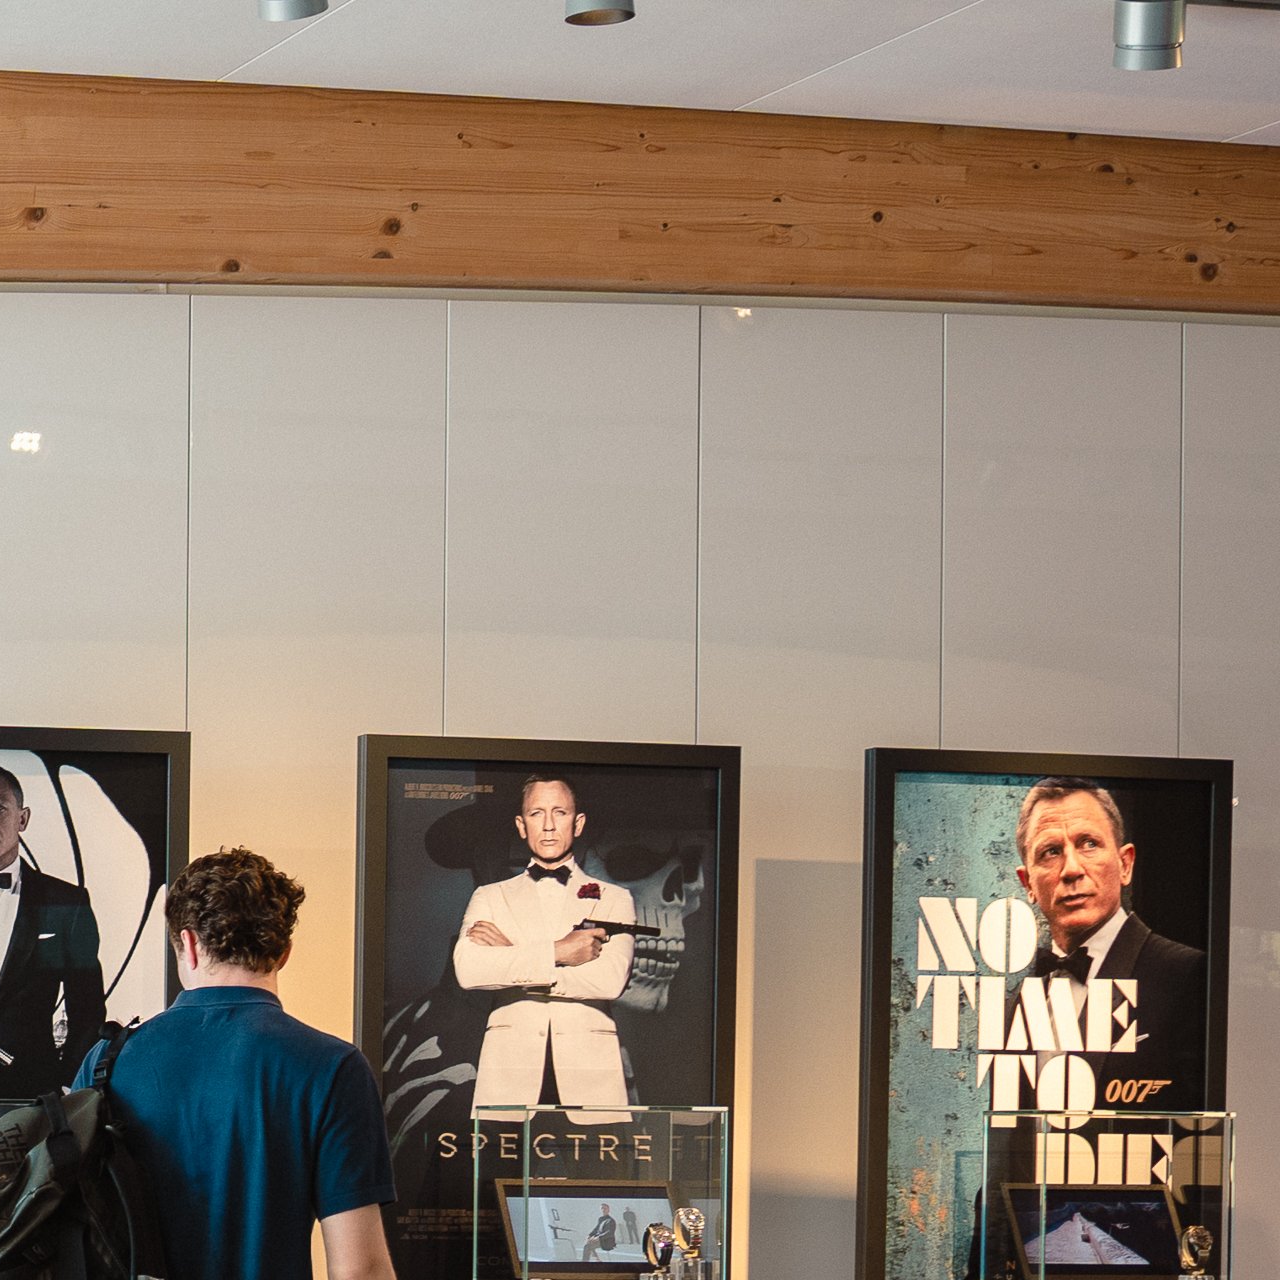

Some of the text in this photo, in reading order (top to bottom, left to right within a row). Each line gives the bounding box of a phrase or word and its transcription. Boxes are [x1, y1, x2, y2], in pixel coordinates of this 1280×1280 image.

[917, 896, 1038, 973] NO
[916, 975, 1138, 1053] TIME
[976, 1054, 1096, 1130] TO
[1105, 1079, 1166, 1103] 007
[437, 1132, 652, 1162] SPECTRE
[1035, 1133, 1173, 1186] DIE
